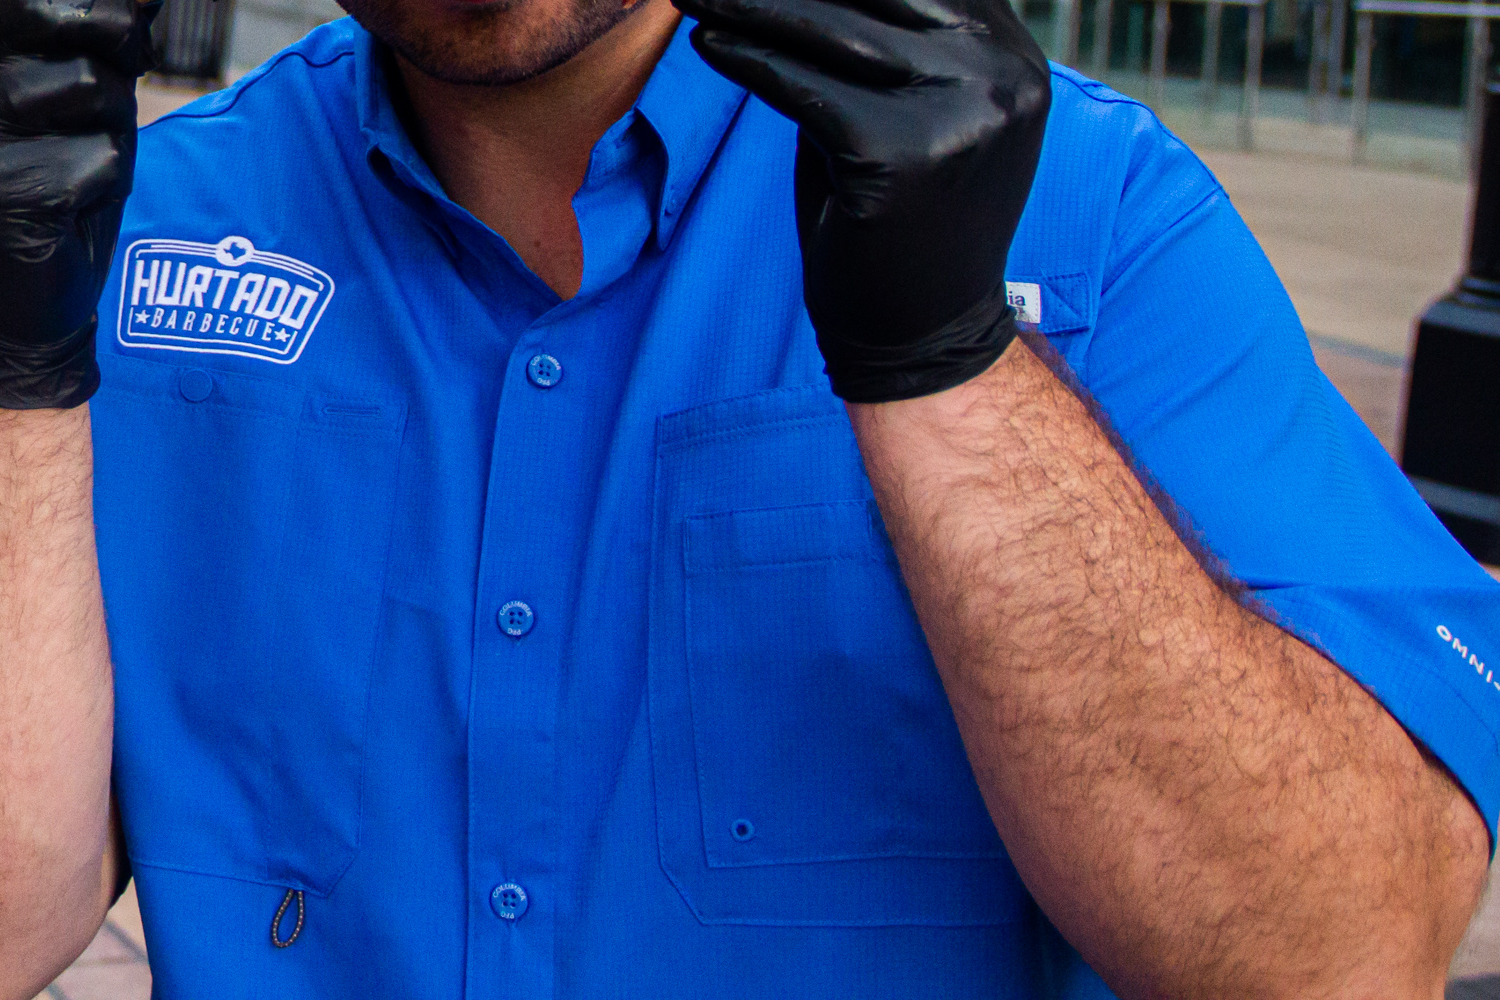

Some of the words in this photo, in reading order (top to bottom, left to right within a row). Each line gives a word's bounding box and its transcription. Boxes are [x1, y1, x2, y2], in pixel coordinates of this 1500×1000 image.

[131, 259, 319, 330] HURTADO
[151, 308, 275, 342] BARBECUE
[493, 884, 527, 902] COLUMBIA
